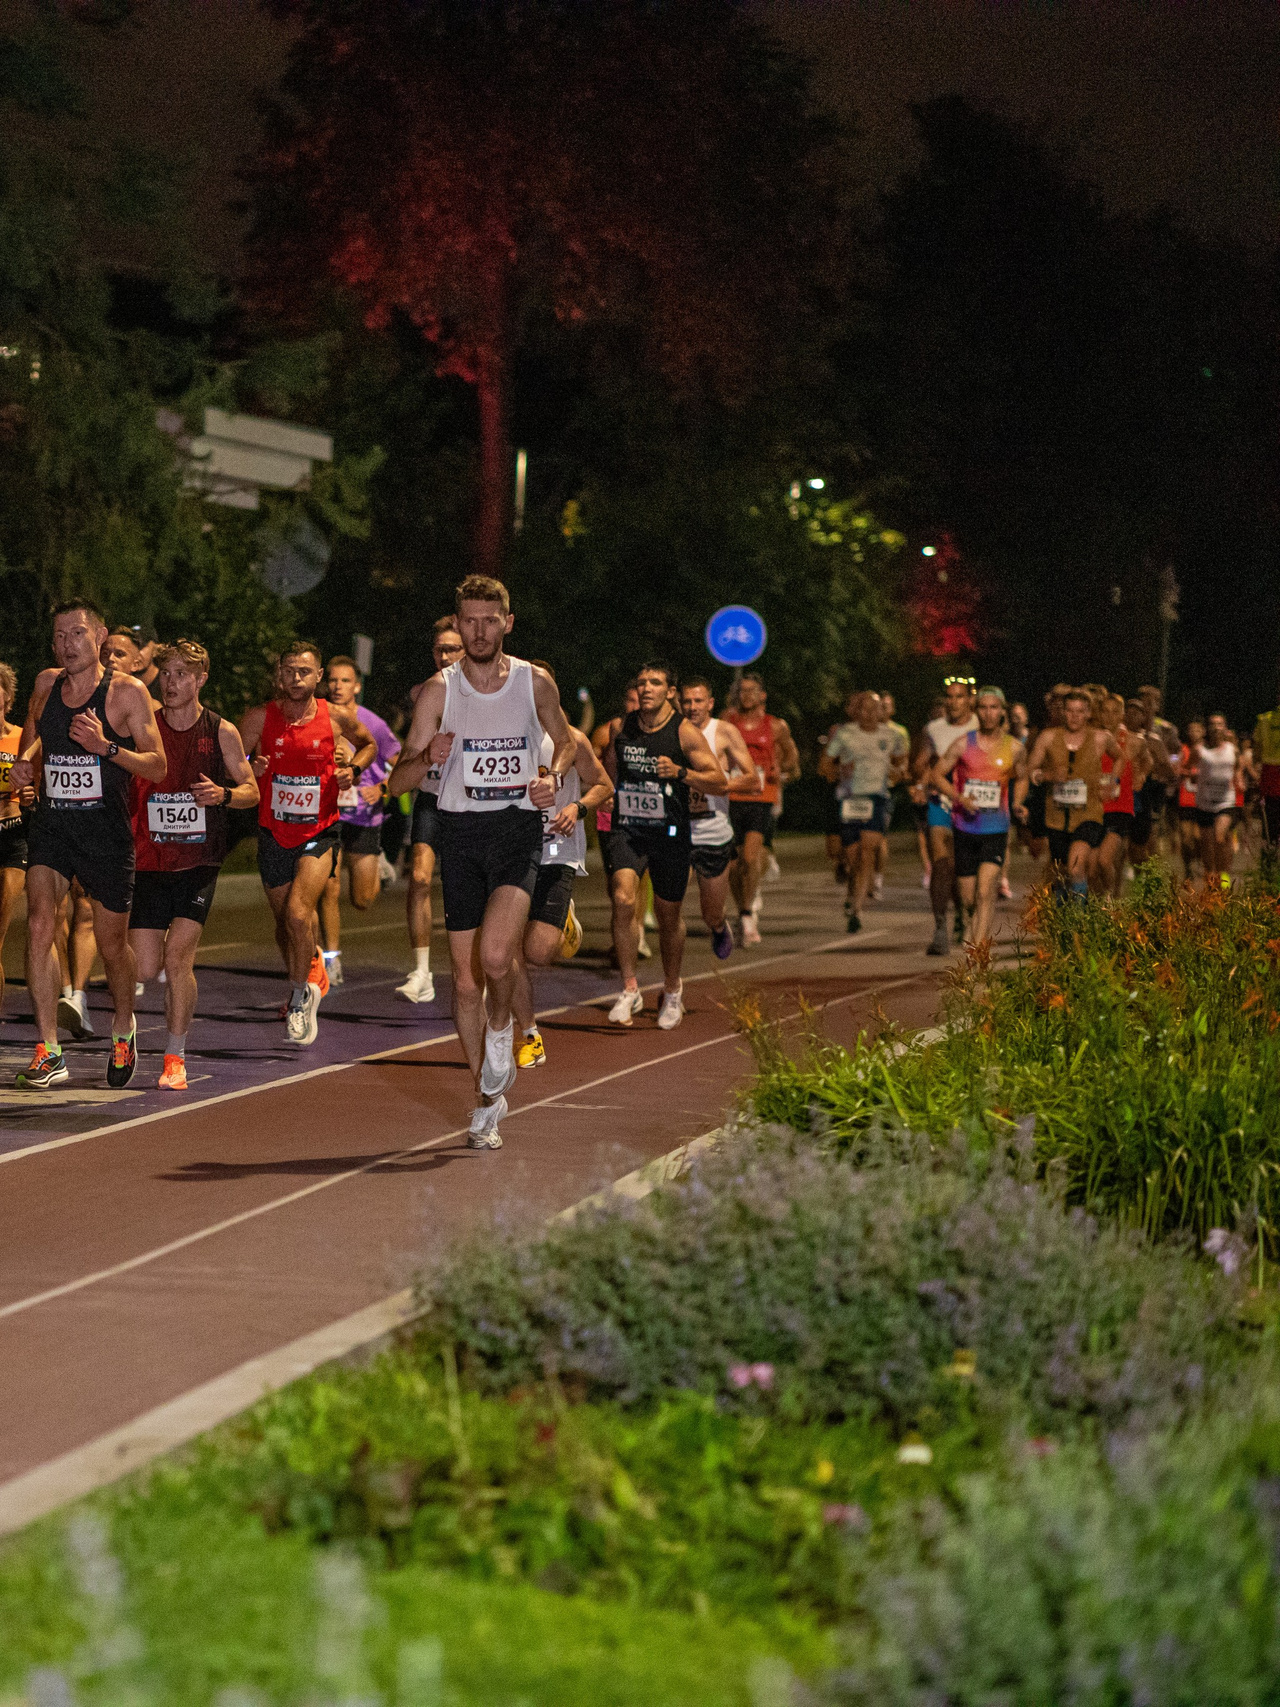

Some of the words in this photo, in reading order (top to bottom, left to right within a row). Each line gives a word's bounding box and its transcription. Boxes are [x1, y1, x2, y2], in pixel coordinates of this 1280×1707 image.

[469, 738, 523, 750] НОЧНОЙ
[49, 753, 95, 765] НОЧНОЙ
[472, 755, 521, 776] 4933
[50, 770, 94, 789] 7033
[278, 790, 314, 808] 9949
[625, 795, 658, 810] 1163
[156, 807, 198, 824] 1540
